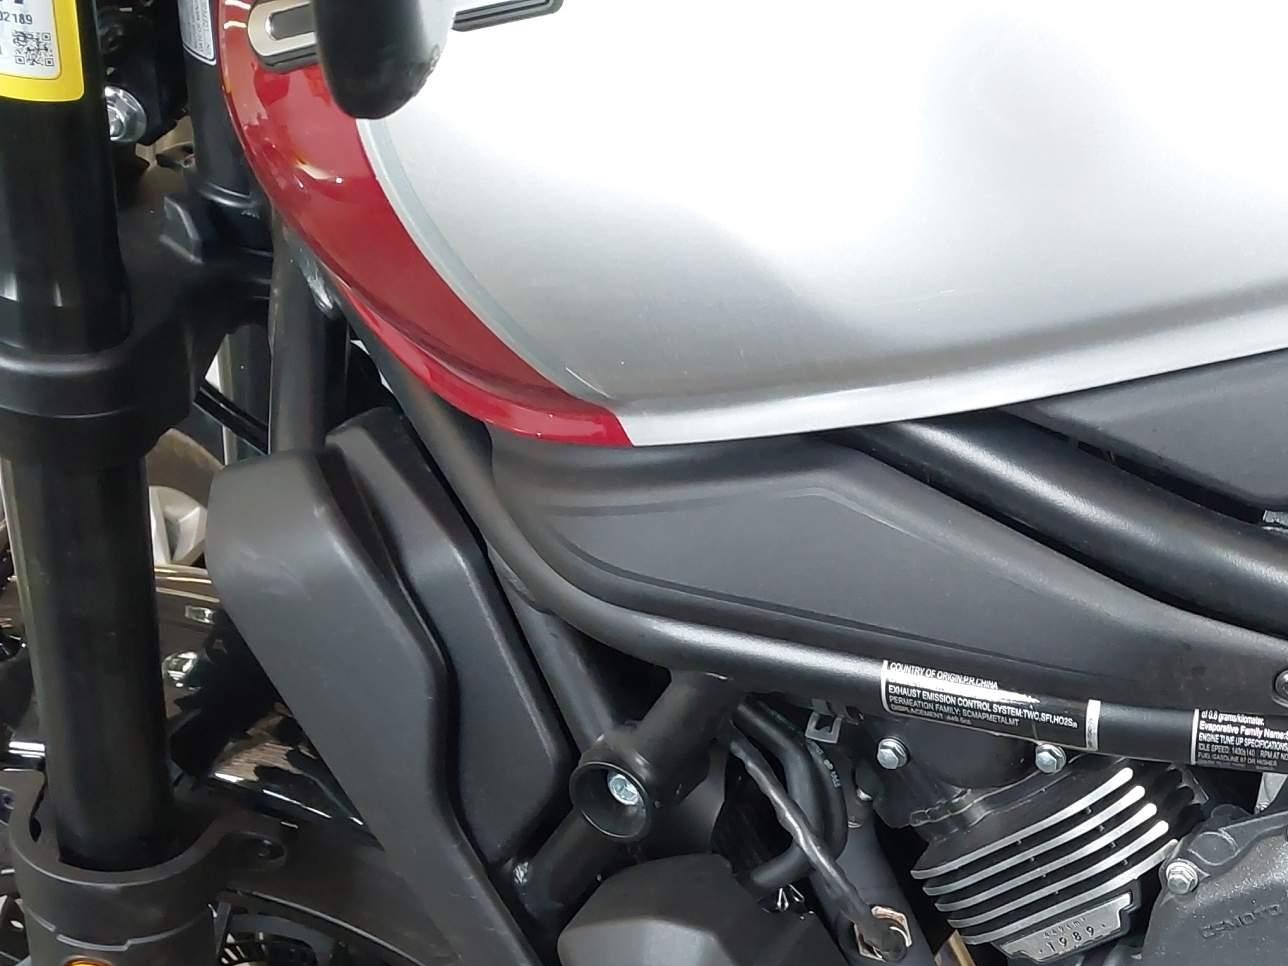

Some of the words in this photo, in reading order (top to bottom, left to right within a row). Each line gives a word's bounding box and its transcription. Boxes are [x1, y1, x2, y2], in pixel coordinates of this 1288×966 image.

[889, 684, 922, 699] EXHAUST
[922, 692, 957, 706] EMISSION
[957, 697, 991, 712] CONTROL
[889, 695, 934, 711] PERMEATION
[1199, 720, 1239, 734] Evaporative
[1240, 725, 1264, 738] Family
[1198, 732, 1219, 744] ENGINE
[1219, 734, 1235, 745] TUNE
[1235, 736, 1244, 746] UP
